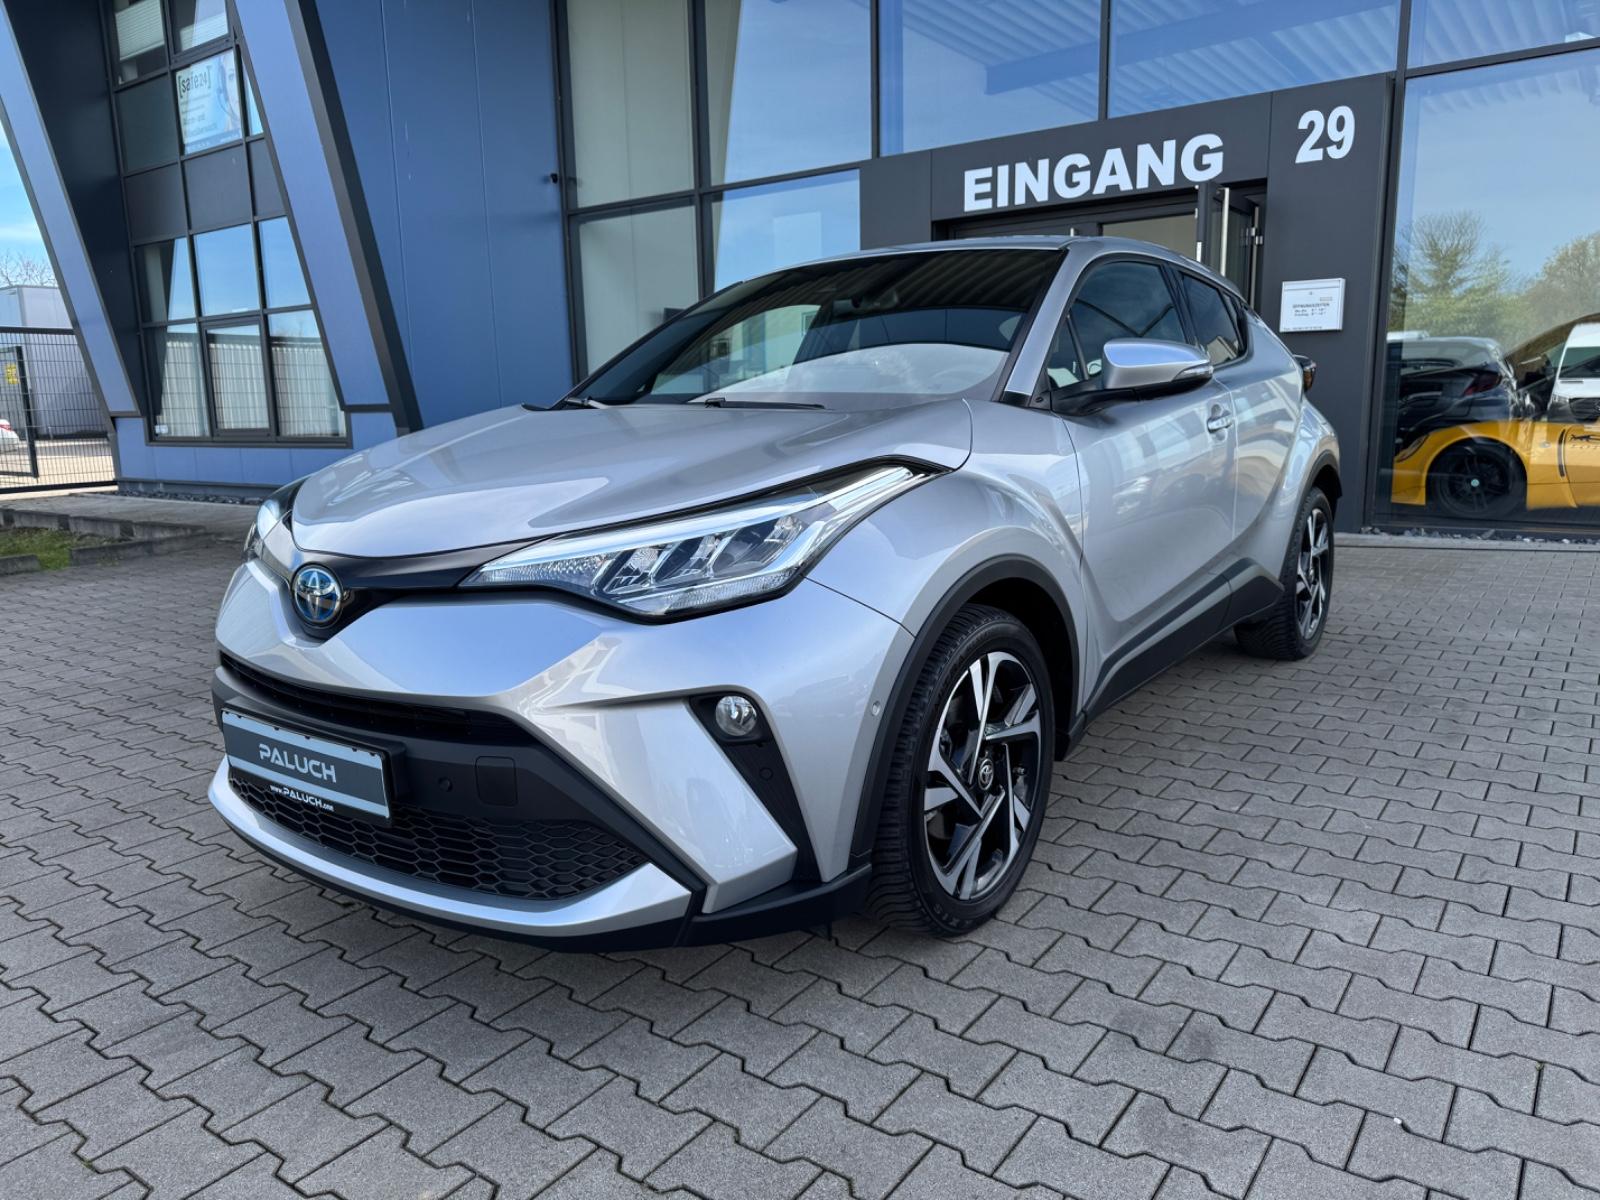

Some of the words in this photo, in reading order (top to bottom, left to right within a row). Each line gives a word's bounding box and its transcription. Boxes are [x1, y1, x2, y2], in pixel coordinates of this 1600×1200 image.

[1295, 105, 1355, 164] 29
[964, 133, 1224, 212] EINGANG
[259, 743, 337, 783] PALUCH
